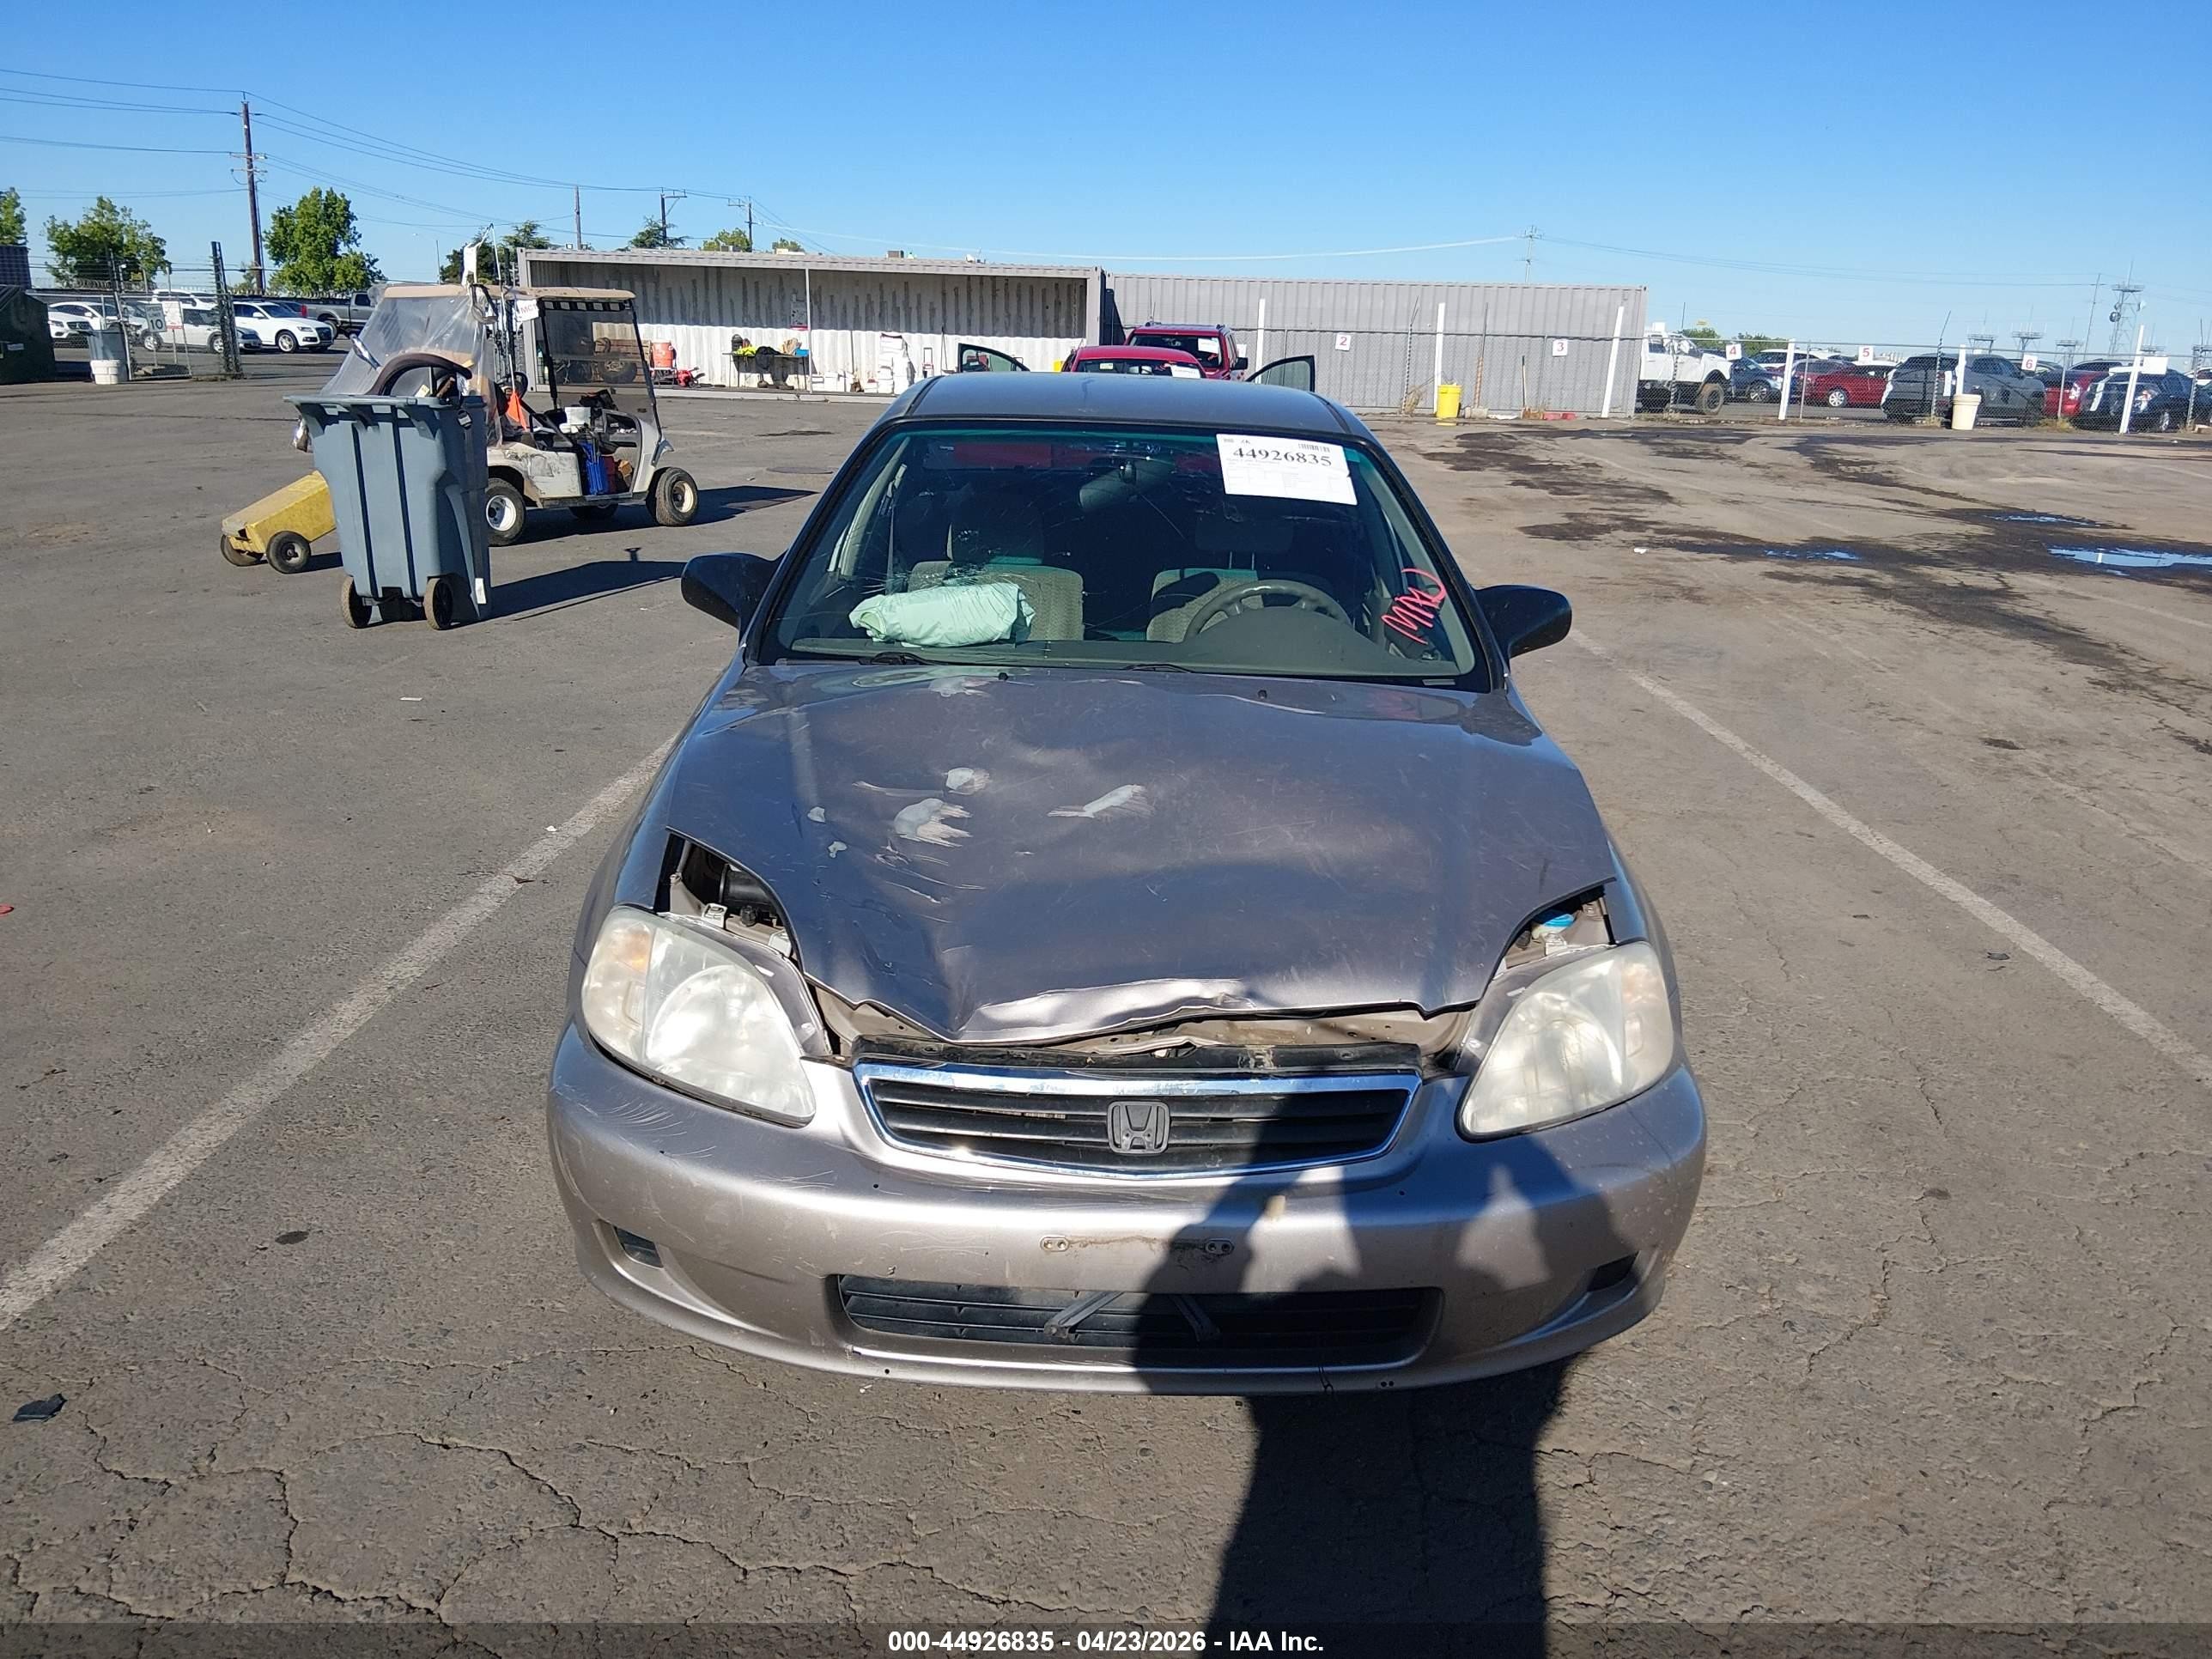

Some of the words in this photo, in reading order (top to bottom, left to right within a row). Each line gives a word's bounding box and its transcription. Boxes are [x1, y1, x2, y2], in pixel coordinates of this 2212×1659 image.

[150, 319, 163, 330] 10
[1340, 336, 1347, 345] 2
[1557, 342, 1565, 352] 3
[1729, 346, 1736, 355] 4
[1863, 347, 1869, 357] 5
[2026, 359, 2033, 368] 6
[1233, 447, 1332, 467] 44926835
